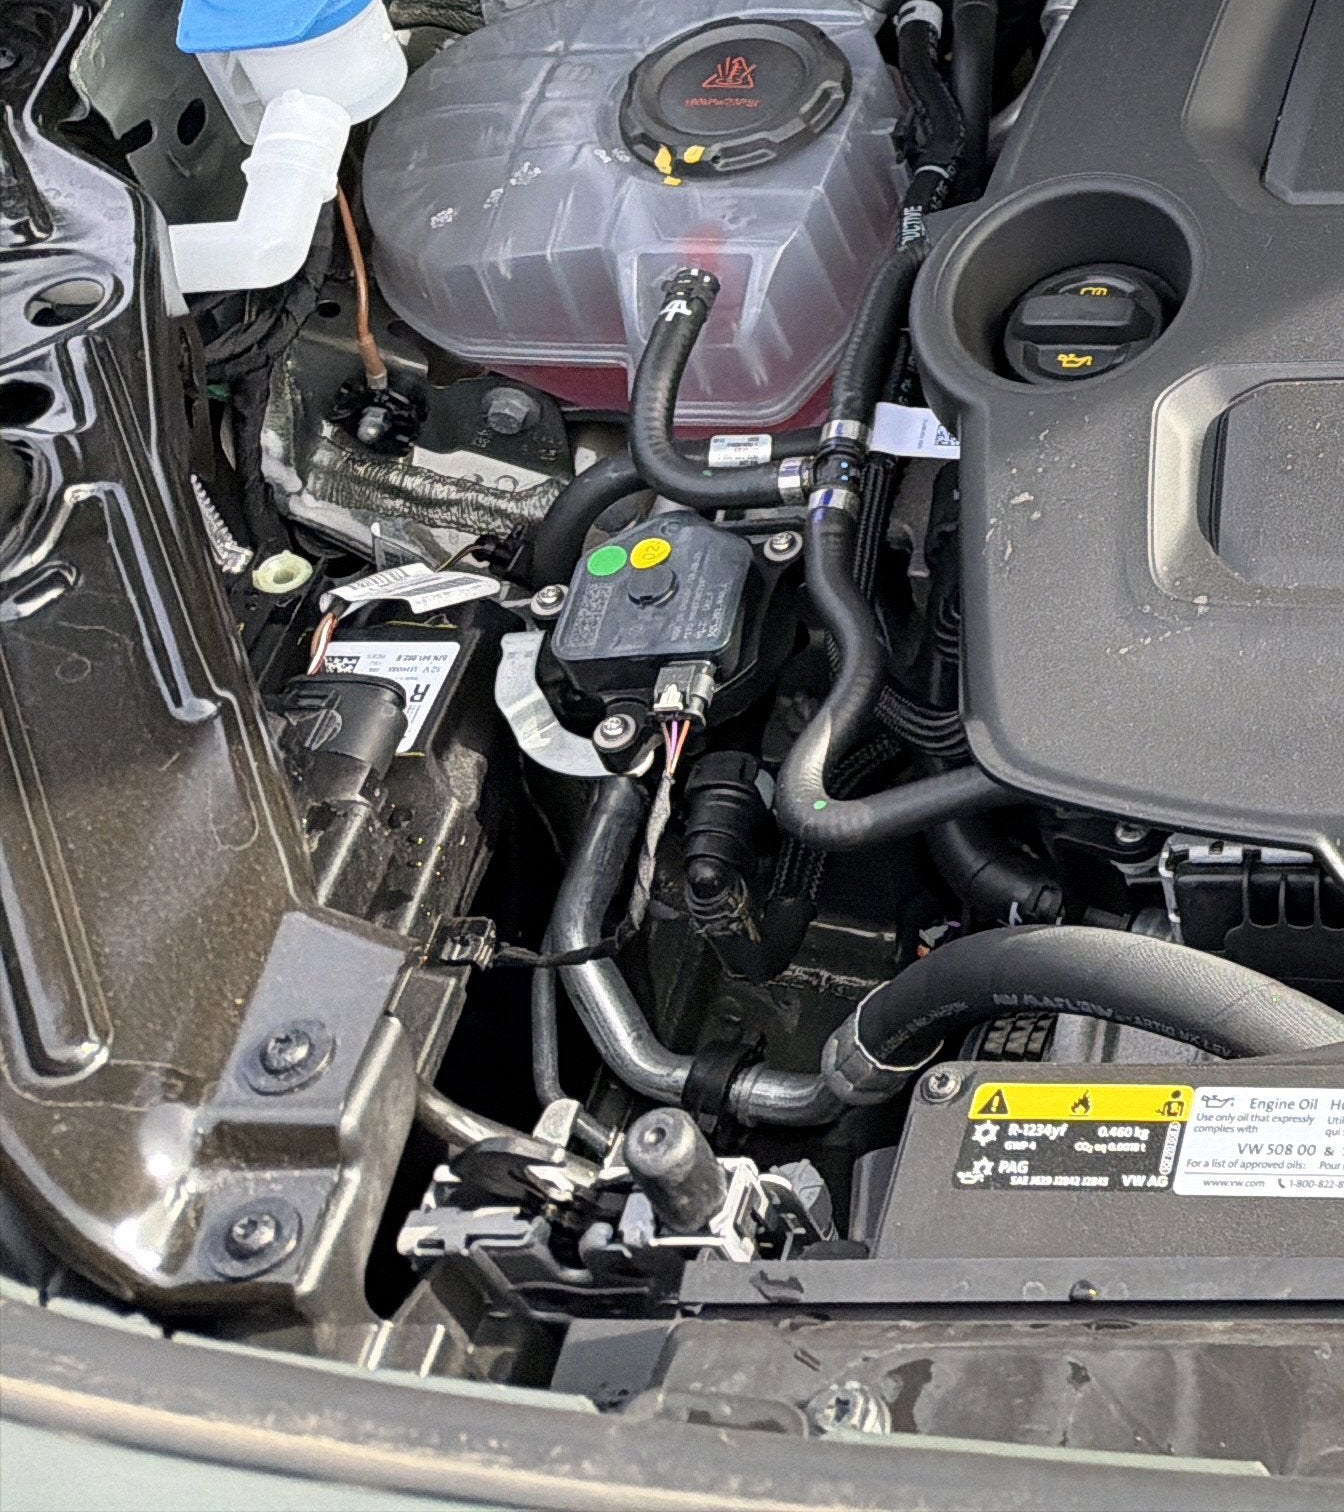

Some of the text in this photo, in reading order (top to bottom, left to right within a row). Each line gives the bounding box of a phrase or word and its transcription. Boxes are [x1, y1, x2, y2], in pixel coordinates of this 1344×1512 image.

[410, 684, 431, 702] R
[1250, 1098, 1318, 1112] Engine Oil
[1196, 1113, 1315, 1125] Use only oil that expressly
[1008, 1124, 1069, 1140] R-1234yf
[1134, 1127, 1150, 1140] kg
[1193, 1124, 1258, 1135] complies with
[1324, 1129, 1340, 1139] qui
[1237, 1143, 1264, 1155] VW
[1266, 1144, 1293, 1156] 508
[1297, 1144, 1316, 1156] 00
[1324, 1146, 1334, 1156] &
[998, 1160, 1029, 1174] PAG
[1186, 1159, 1201, 1168] For
[1212, 1159, 1226, 1168] list
[1228, 1159, 1239, 1168] of
[1240, 1160, 1285, 1172] approved
[1319, 1161, 1341, 1170] Pour
[1122, 1175, 1169, 1188] VW AG
